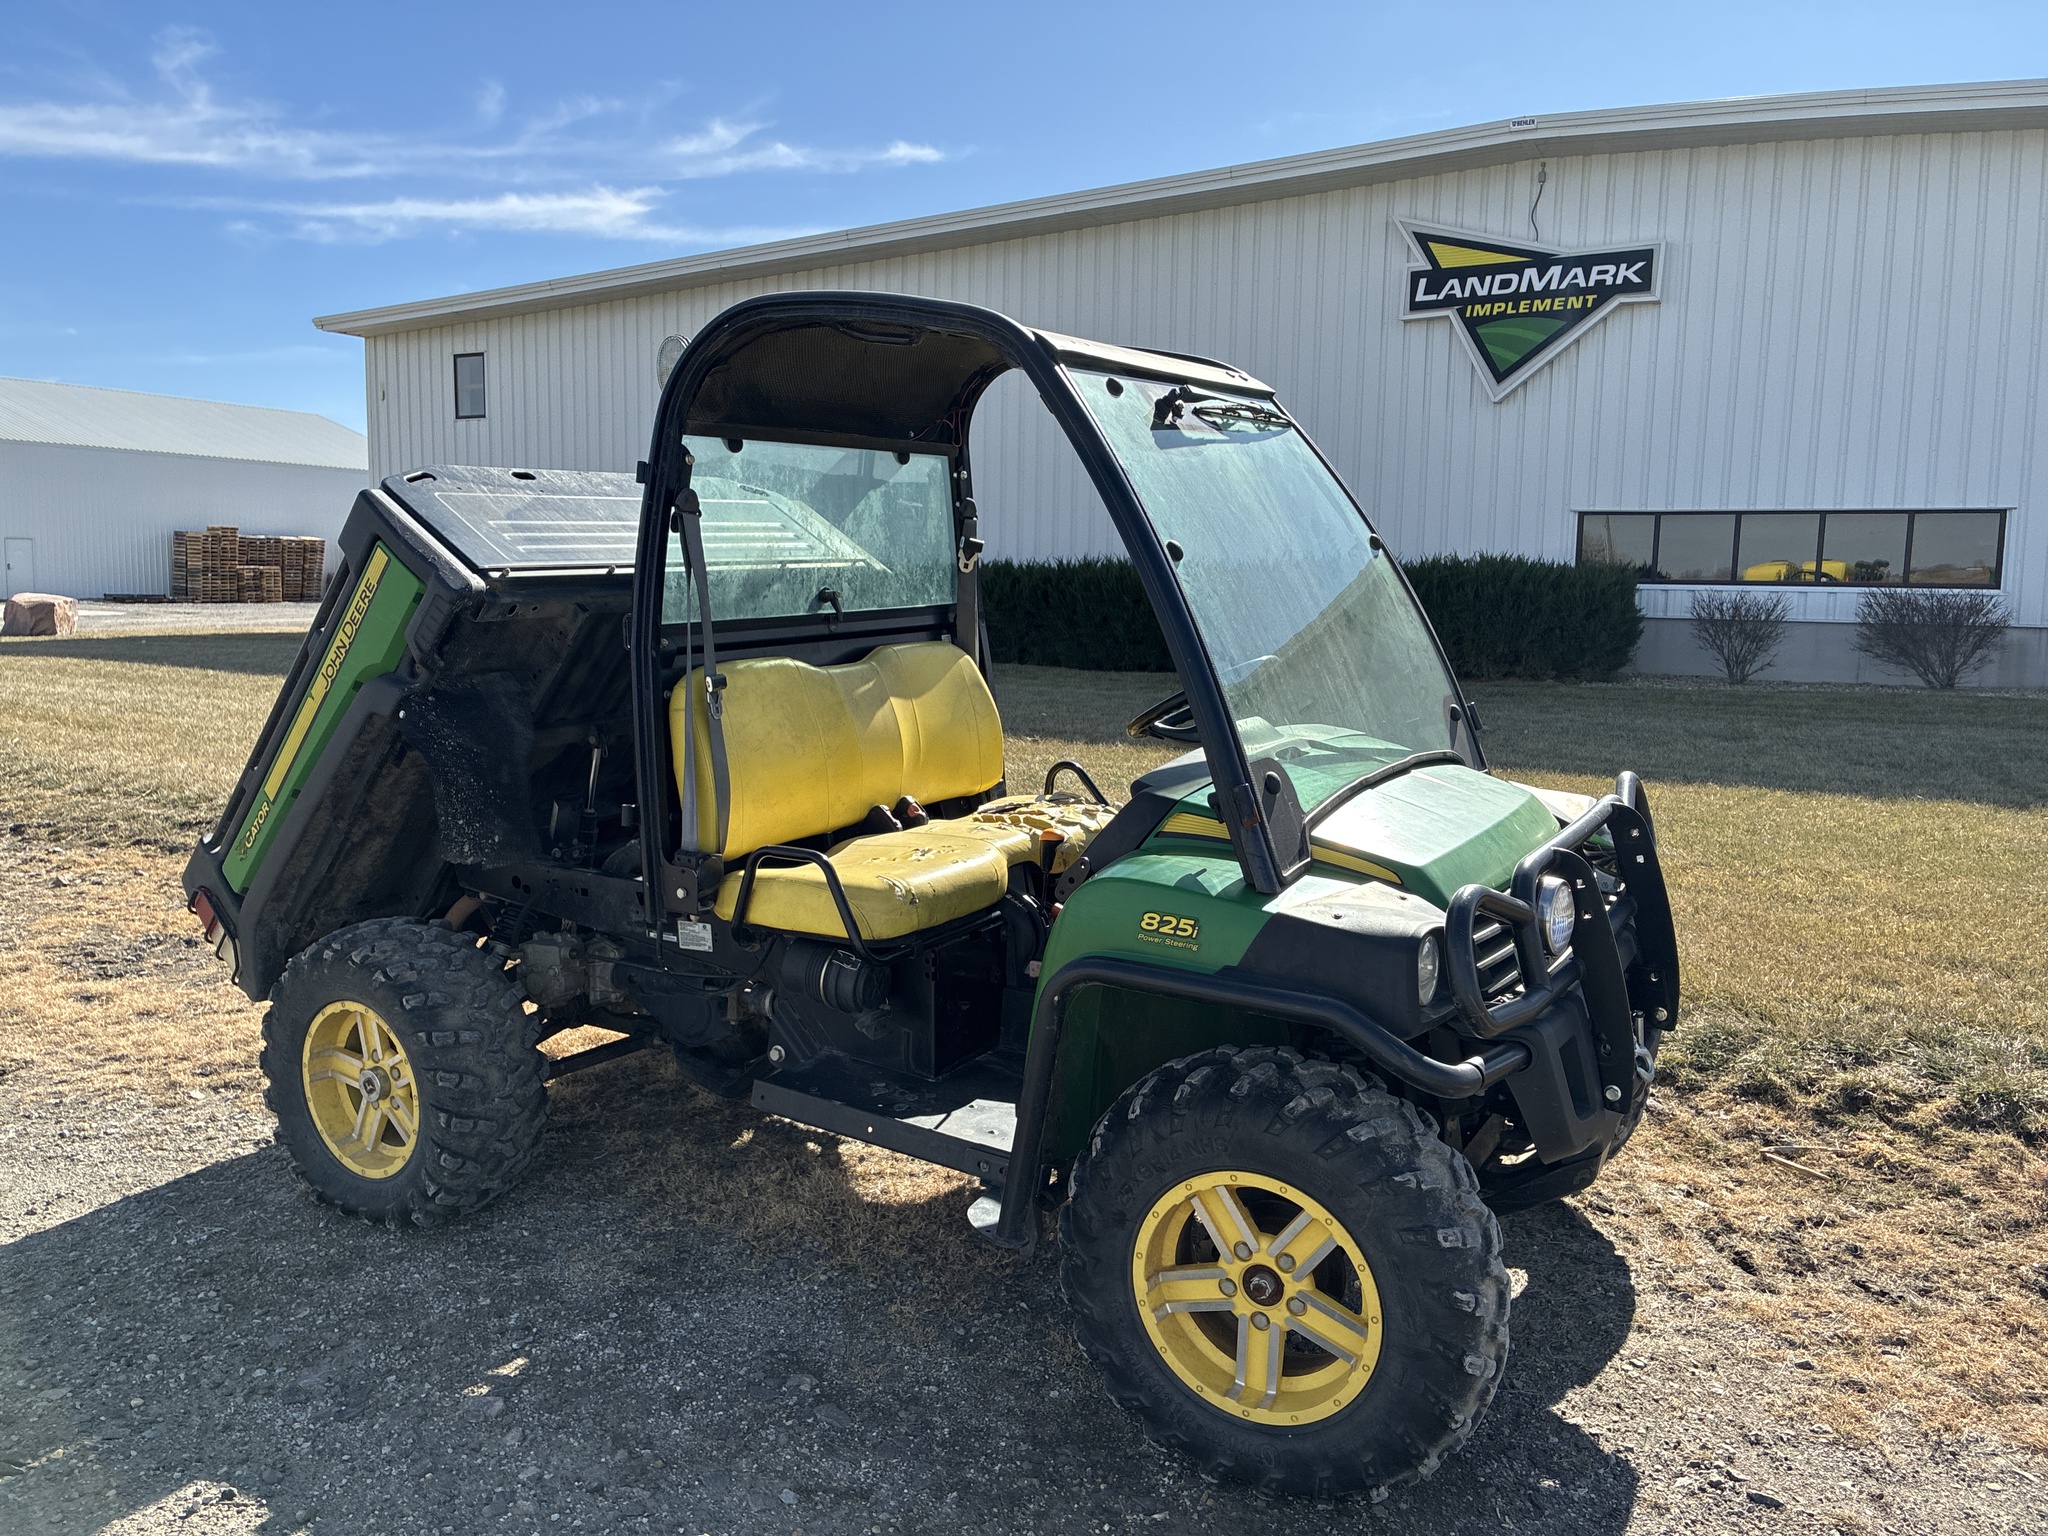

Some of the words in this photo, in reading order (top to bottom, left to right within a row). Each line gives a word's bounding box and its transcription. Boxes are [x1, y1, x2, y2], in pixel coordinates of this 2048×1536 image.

[1465, 294, 1598, 318] IMPLEMENT
[321, 638, 348, 690] JOHN
[341, 577, 376, 640] DEERE
[245, 800, 270, 848] GATOR
[1140, 911, 1200, 939] 825i
[1137, 933, 1163, 944] Power
[1164, 938, 1199, 951] Steering
[1183, 1136, 1229, 1157] NHS
